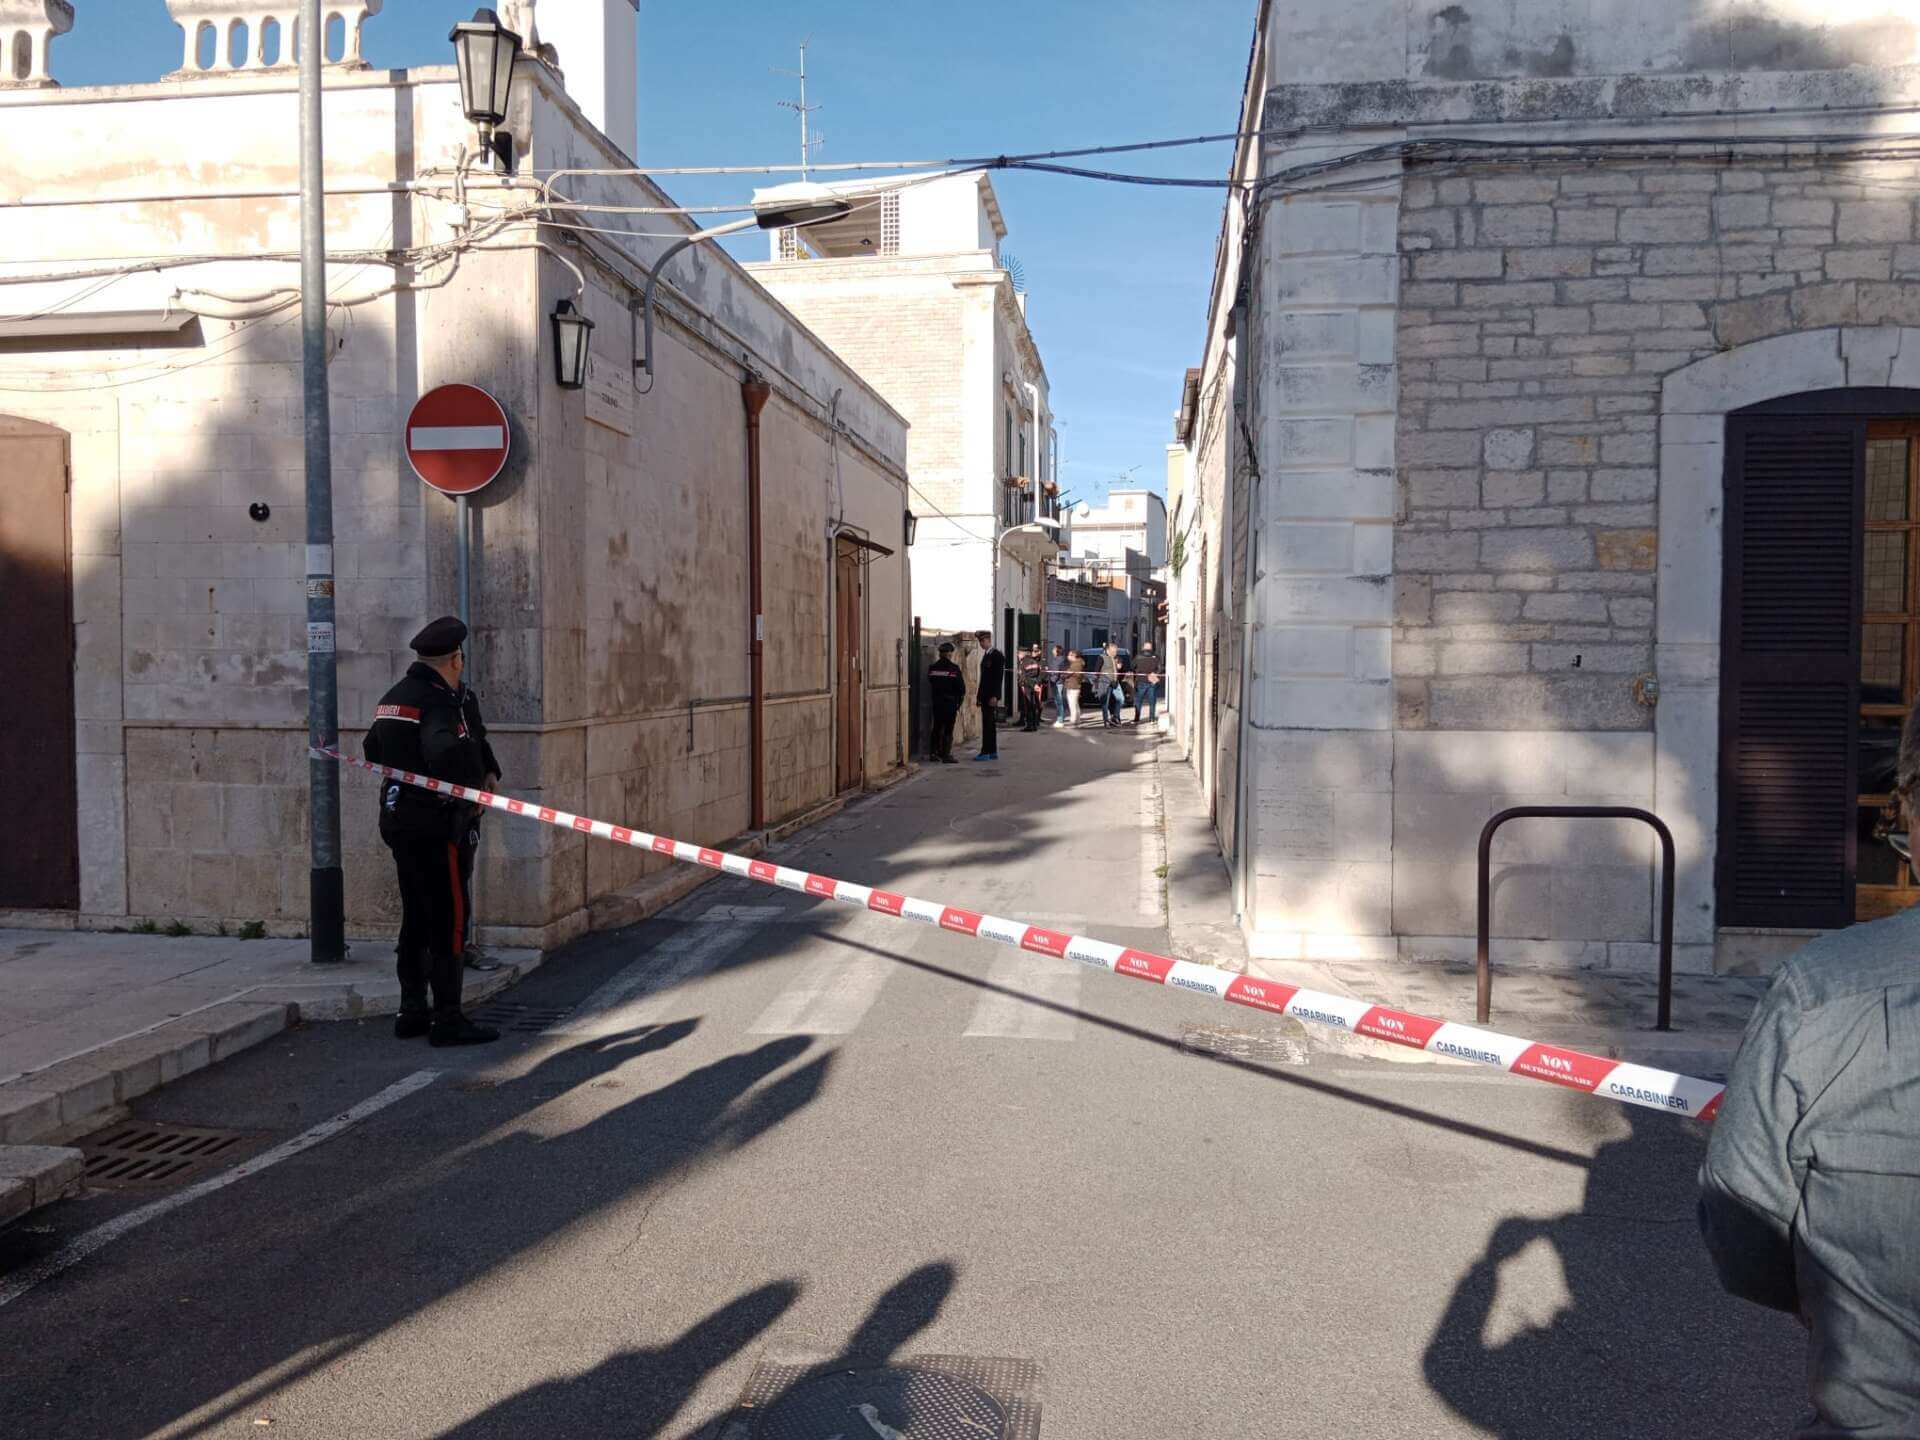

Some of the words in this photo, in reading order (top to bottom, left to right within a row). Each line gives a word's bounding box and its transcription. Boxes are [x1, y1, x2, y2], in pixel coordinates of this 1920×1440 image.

[1128, 957, 1149, 970] NON
[1242, 983, 1266, 998] NON
[1292, 1006, 1347, 1026] CARABINIERI
[1377, 1015, 1406, 1032] NON
[1361, 1024, 1423, 1045] OLTREPASSARE
[1436, 1041, 1502, 1065] CARABINIERI
[1539, 1054, 1573, 1073] NON
[1520, 1063, 1594, 1087] OLTREPASSARE
[1610, 1082, 1689, 1111] CARABINIERI
